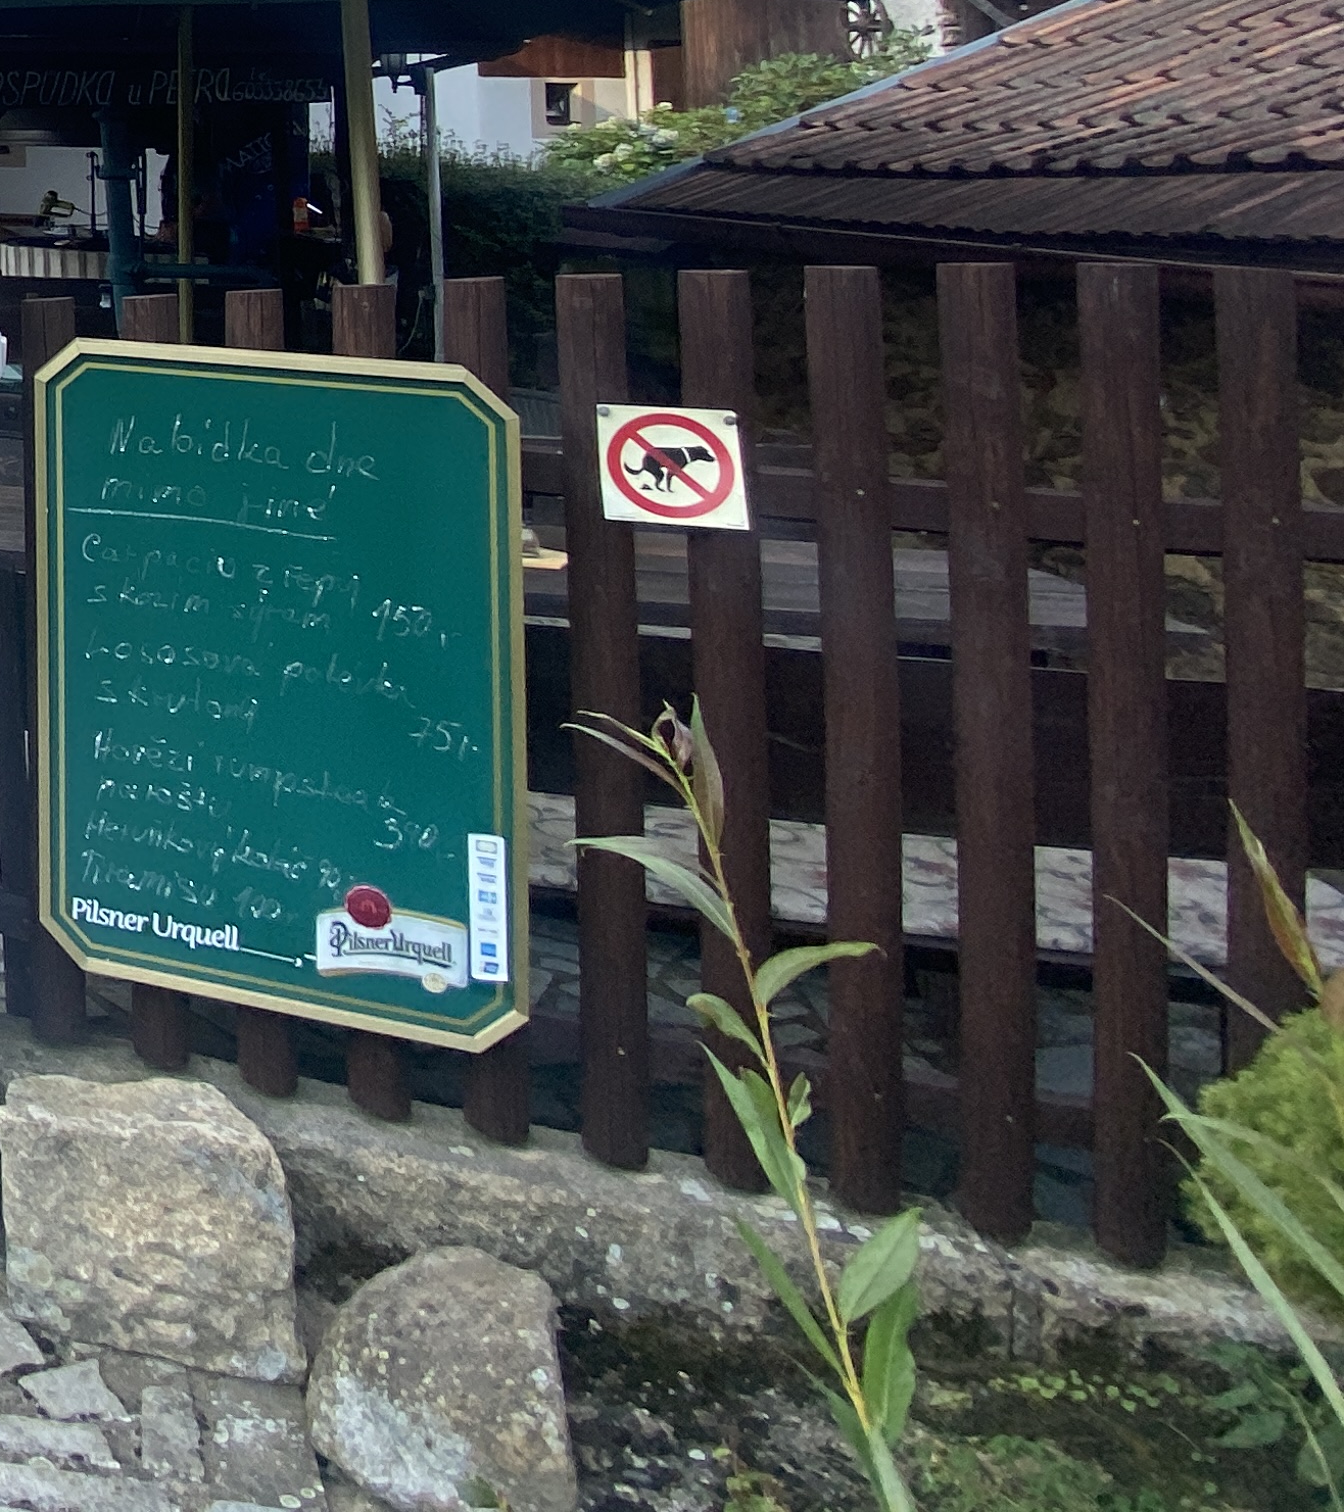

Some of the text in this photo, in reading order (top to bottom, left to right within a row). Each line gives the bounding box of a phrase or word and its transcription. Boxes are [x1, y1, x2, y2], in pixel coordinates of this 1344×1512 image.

[148, 67, 231, 105] PERA
[110, 413, 380, 481] Nabídka dne
[71, 895, 240, 952] Pilsner Urquell
[329, 921, 453, 965] Pilsner Urquell
